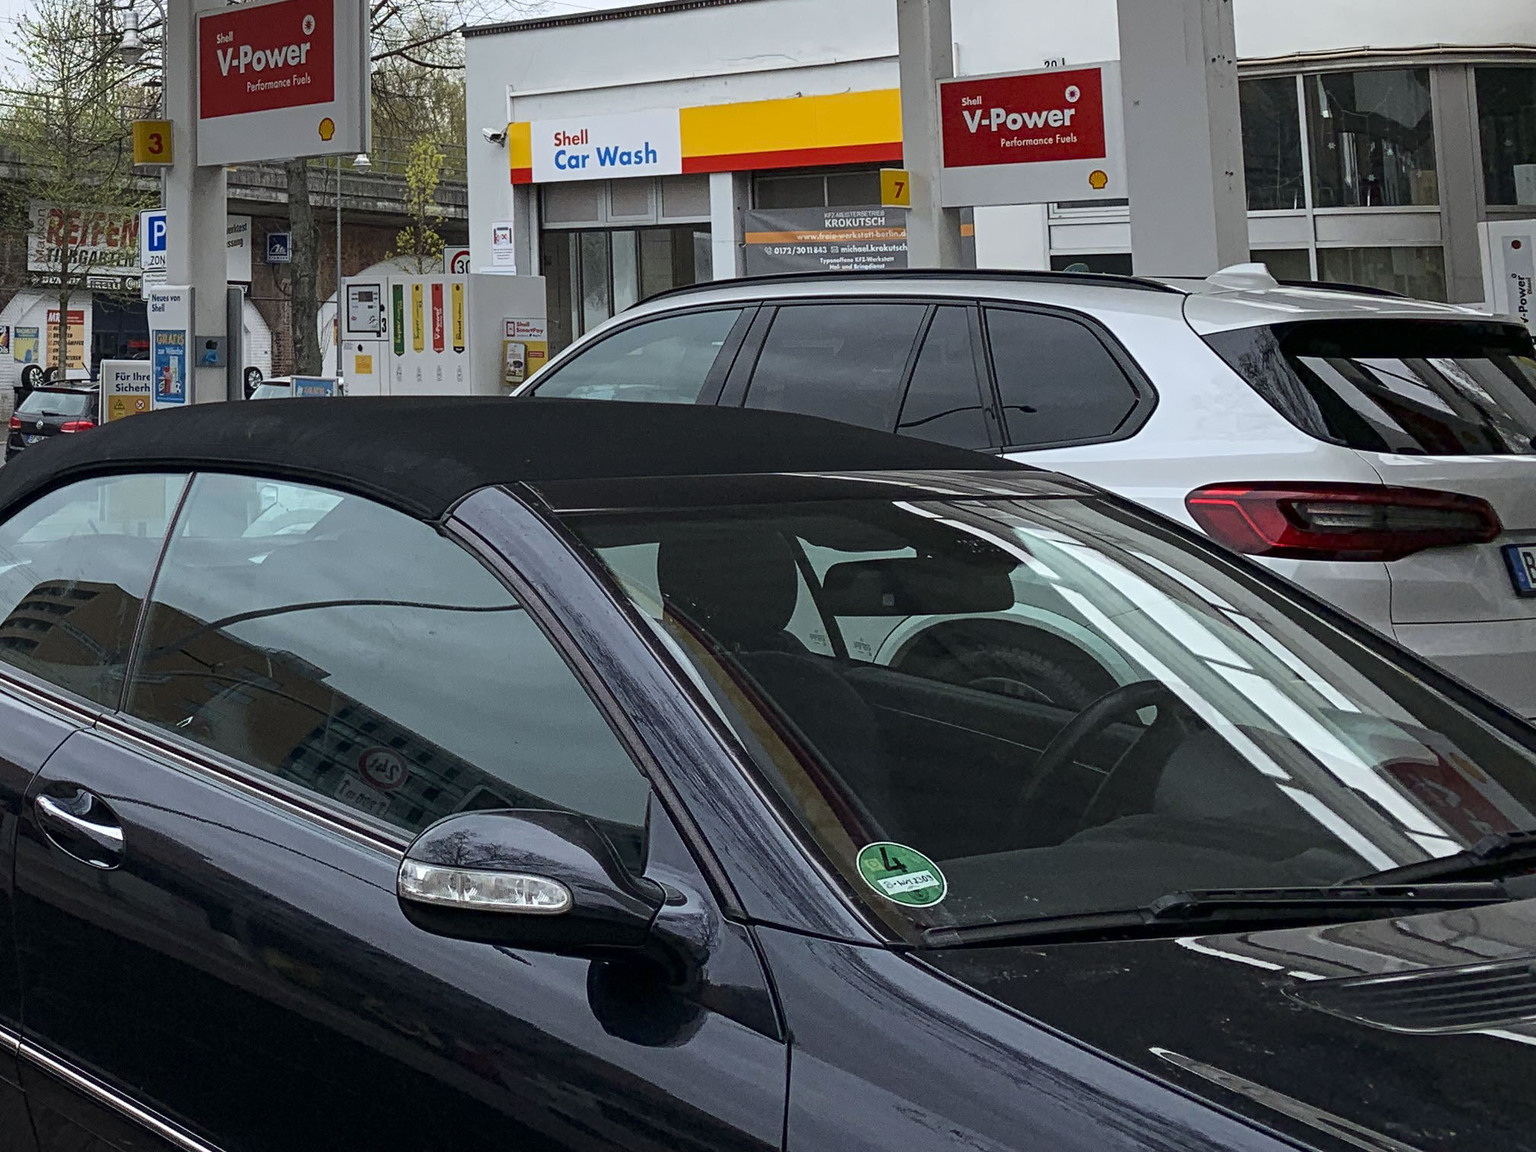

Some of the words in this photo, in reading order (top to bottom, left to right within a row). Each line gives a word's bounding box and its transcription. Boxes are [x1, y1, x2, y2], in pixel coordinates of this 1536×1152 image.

[216, 31, 234, 44] Shell
[216, 42, 311, 77] V-Power
[246, 77, 291, 93] Performance
[292, 72, 312, 87] Fuels
[961, 96, 982, 107] Shell
[962, 107, 1076, 134] V-Power
[148, 132, 164, 155] 3
[553, 128, 589, 147] Shell
[1000, 135, 1054, 148] Performance
[1055, 133, 1078, 145] Fuels
[554, 149, 590, 170] Car
[595, 141, 657, 167] Wash
[894, 181, 905, 198] 7
[46, 208, 140, 248] REIFEN
[824, 217, 886, 228] KROKUTSCH
[154, 220, 167, 247] P
[796, 229, 907, 241] www.freie-werkstatt-berlin.d
[840, 244, 908, 254] michael.krokutsch
[46, 248, 135, 267] TIRGARTEN
[150, 255, 166, 266] ZON
[151, 294, 169, 302] Neues
[170, 294, 181, 302] von
[151, 303, 165, 312] Shell
[115, 371, 131, 381] Für
[115, 383, 151, 393] Sicherh
[879, 846, 908, 873] 4
